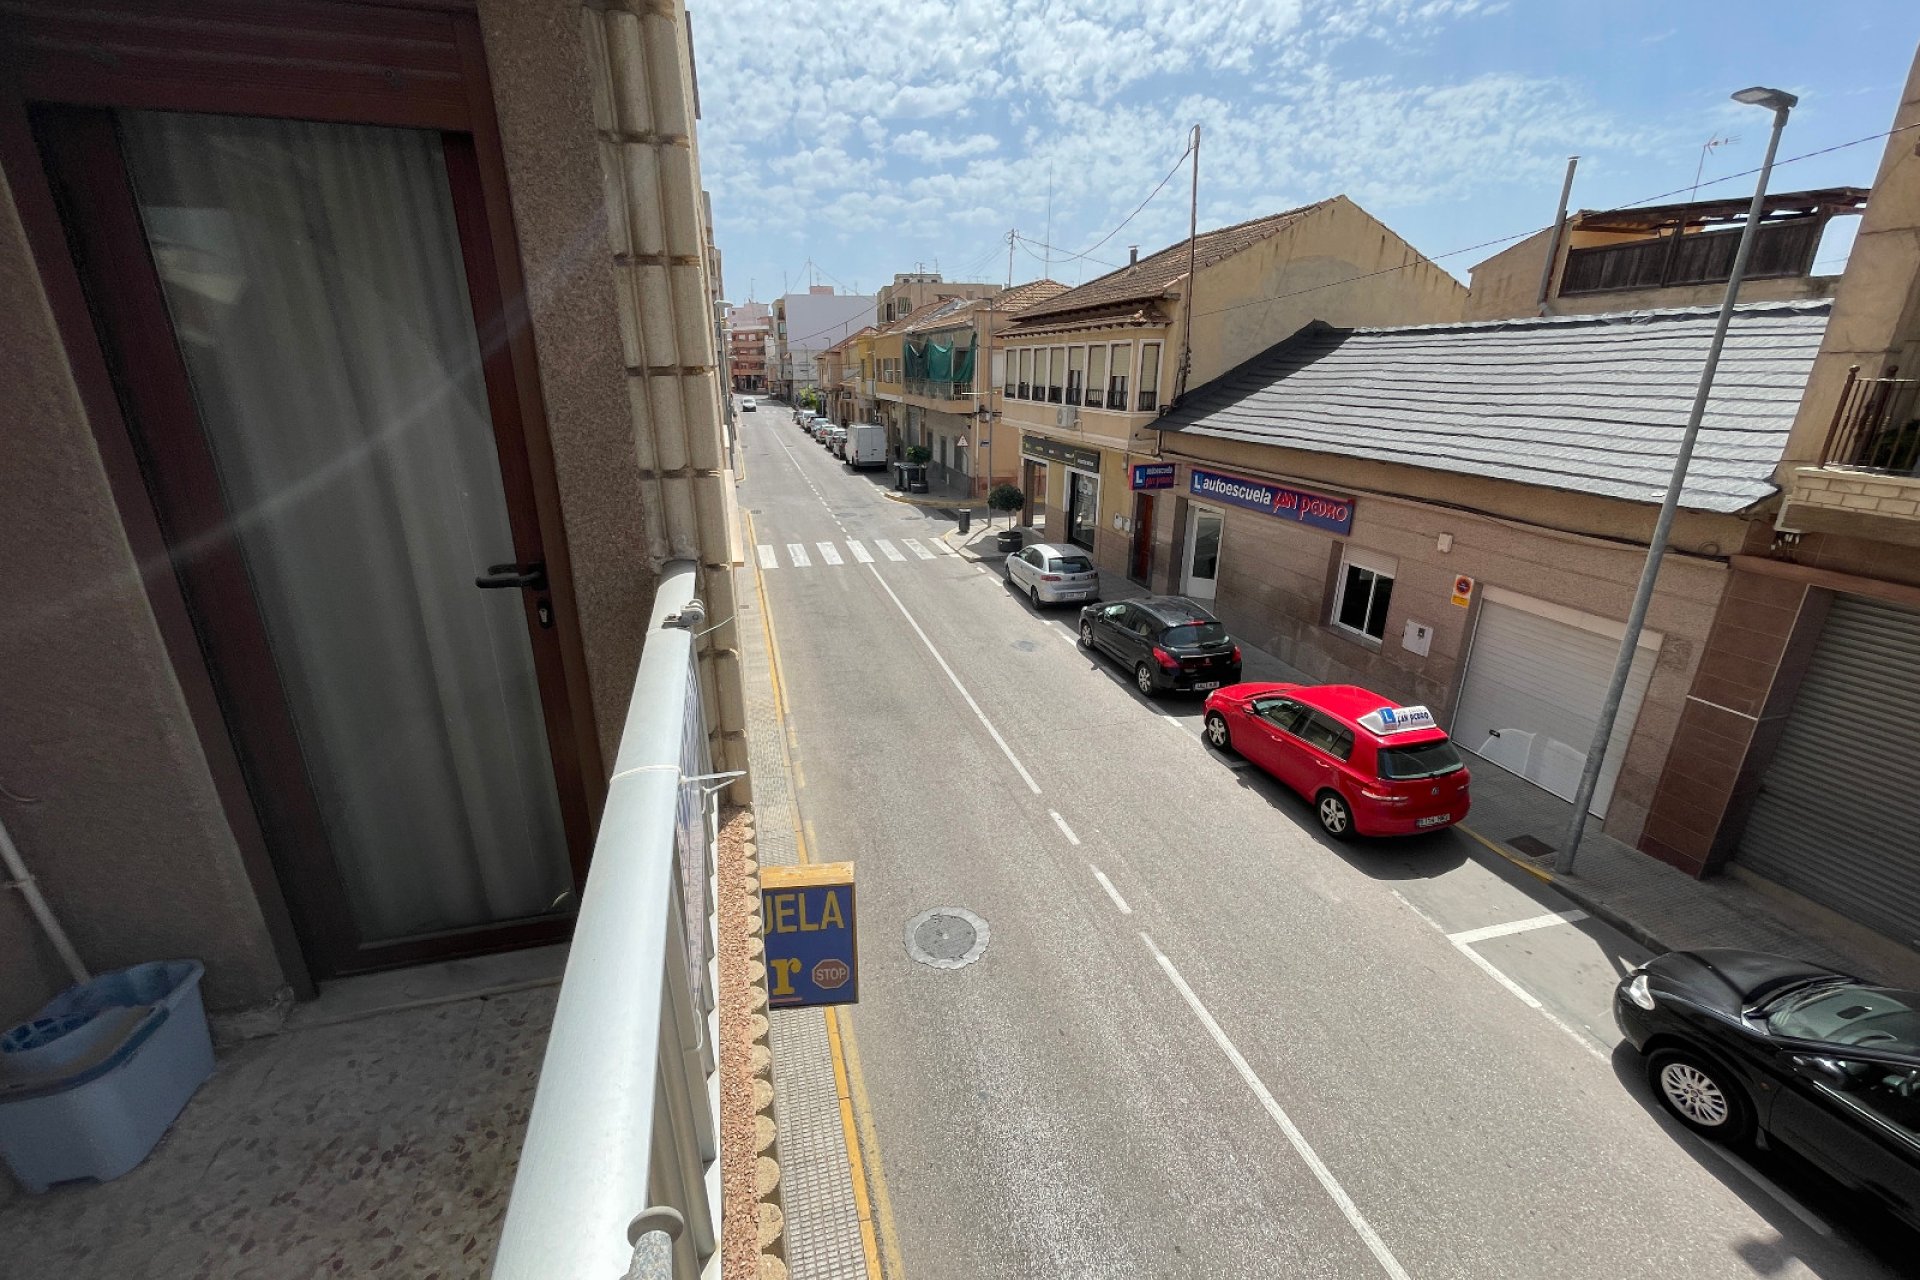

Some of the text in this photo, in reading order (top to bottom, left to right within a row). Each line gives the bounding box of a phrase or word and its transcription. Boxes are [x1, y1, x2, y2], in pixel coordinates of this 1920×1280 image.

[1136, 470, 1143, 483] L
[1203, 478, 1272, 505] autoescuela
[1383, 710, 1393, 722] L
[815, 967, 847, 981] STOP
